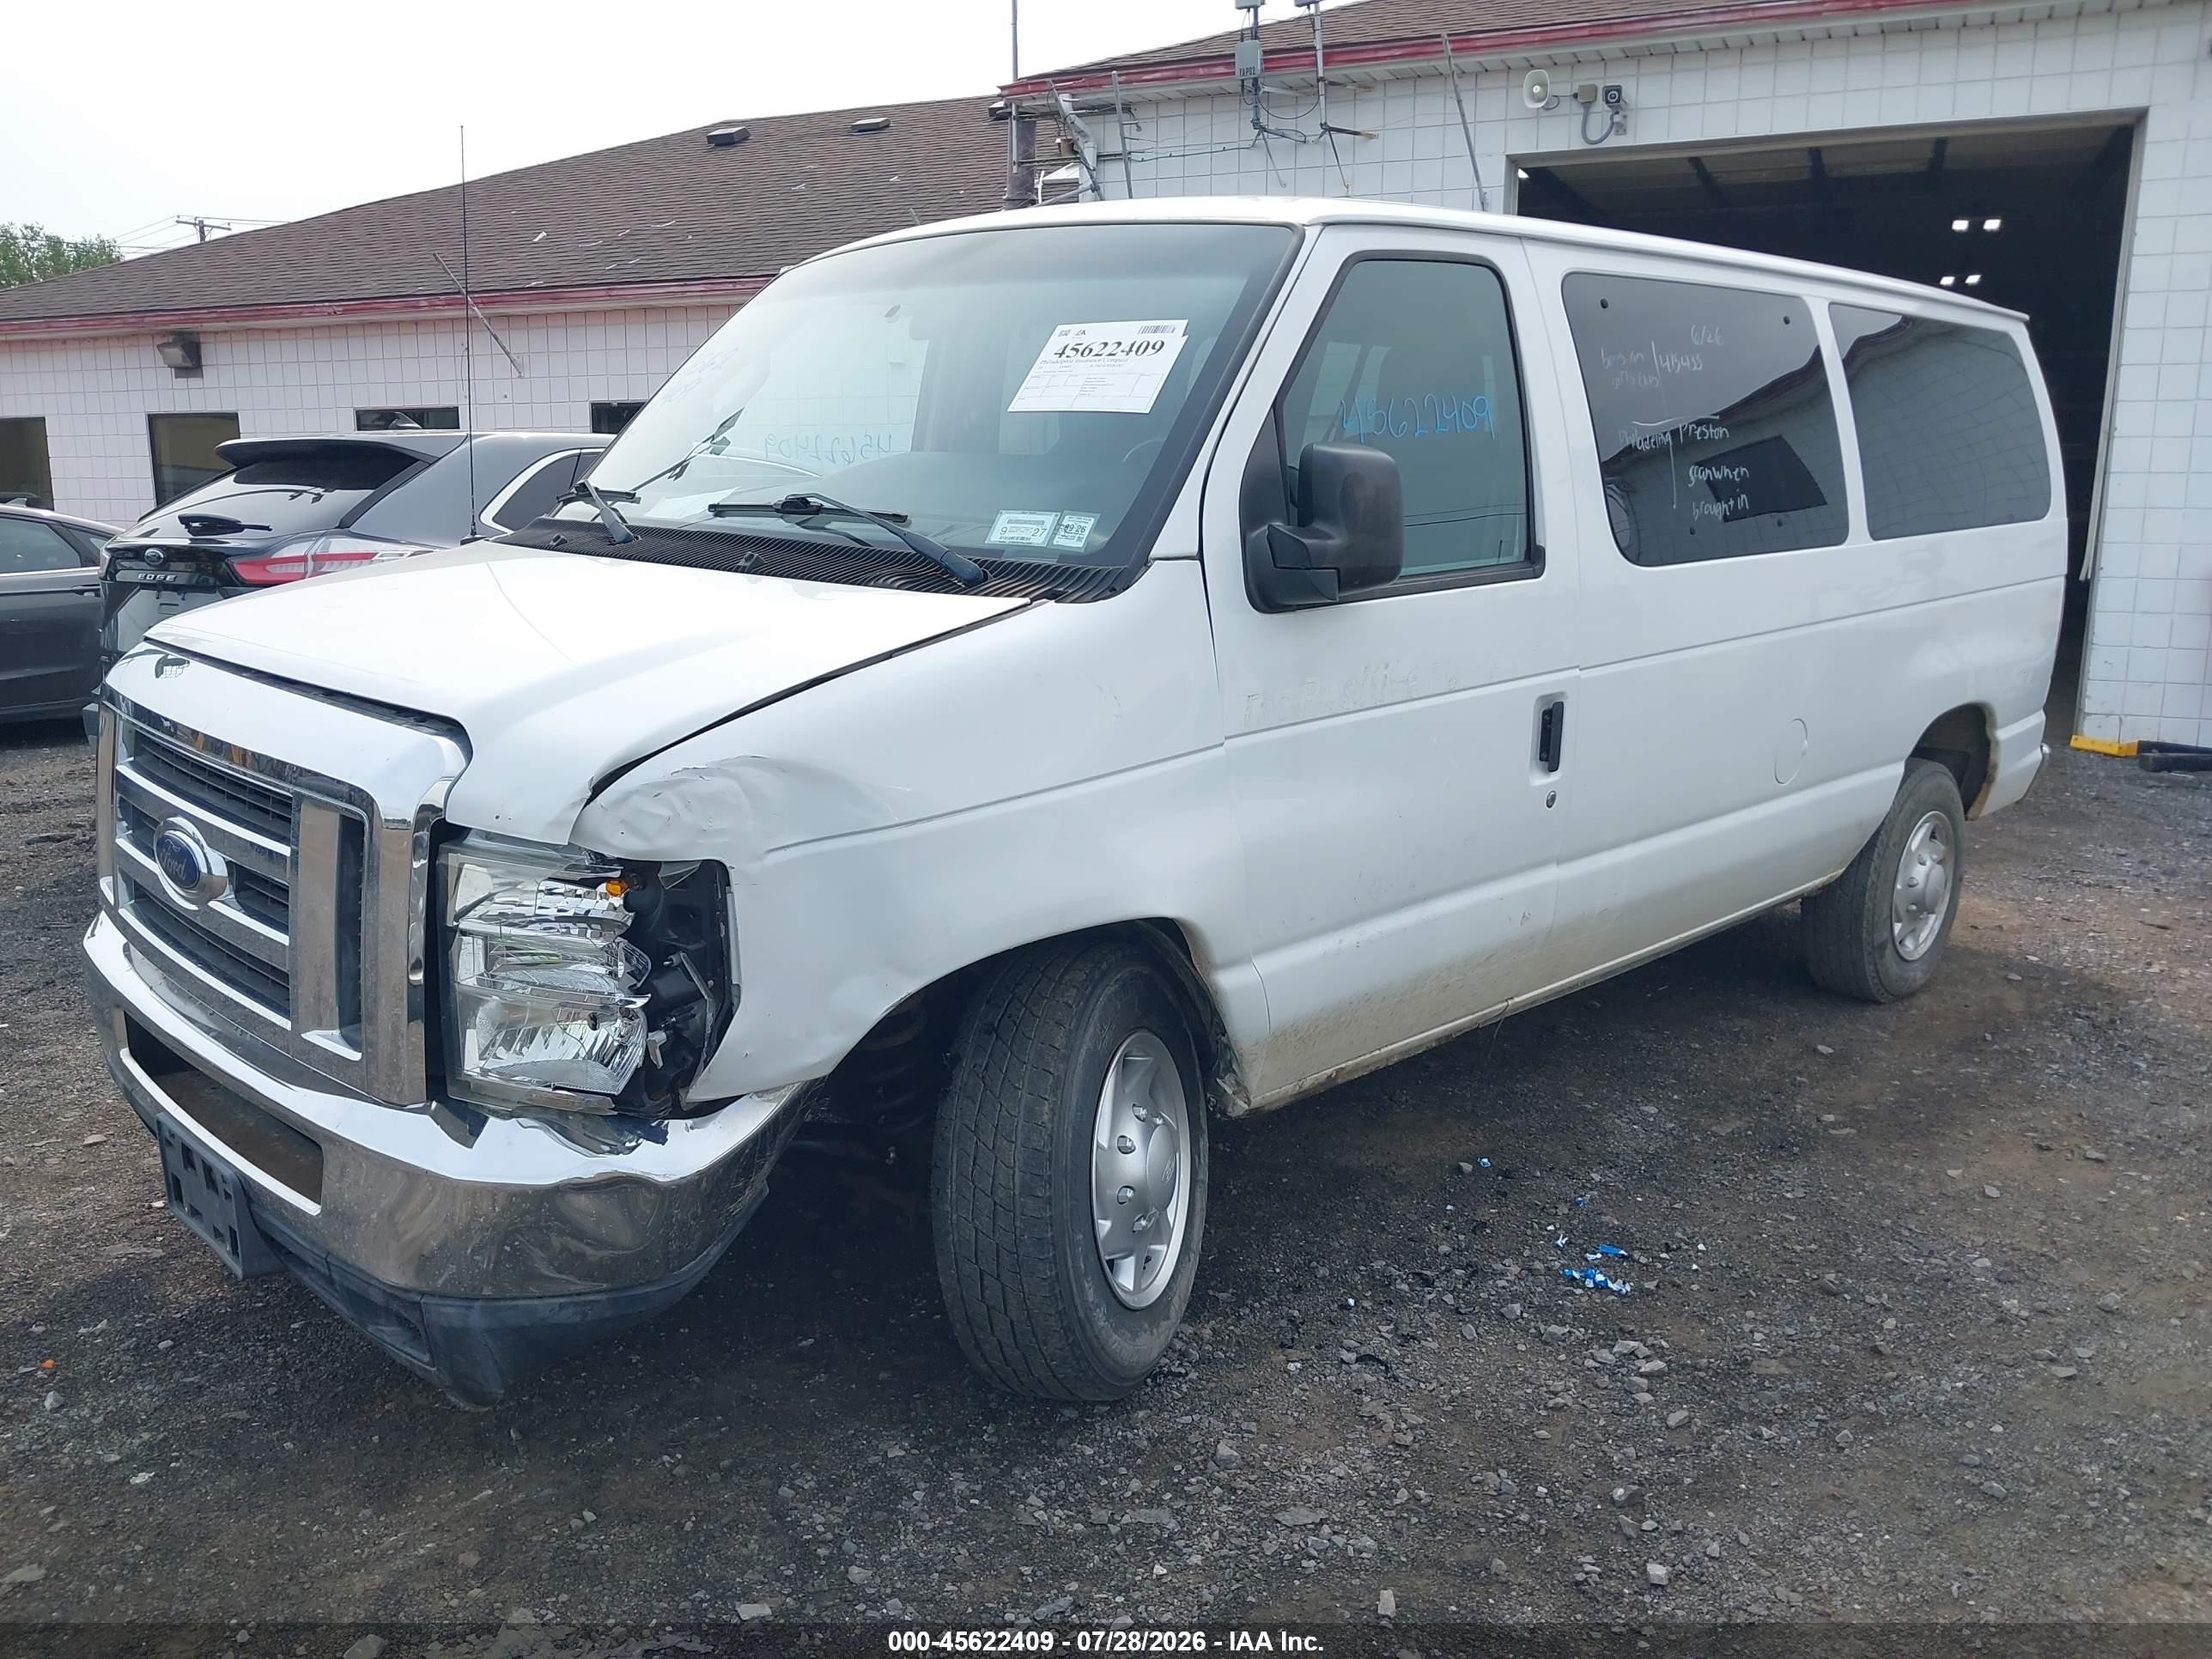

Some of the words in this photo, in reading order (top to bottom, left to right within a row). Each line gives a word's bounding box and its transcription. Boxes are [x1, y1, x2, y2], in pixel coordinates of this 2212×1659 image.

[1054, 339, 1166, 359] 45622409
[1341, 393, 1497, 446] 45622409
[1736, 489, 1749, 510] in
[1031, 527, 1047, 538] 27
[137, 573, 178, 581] EDGE
